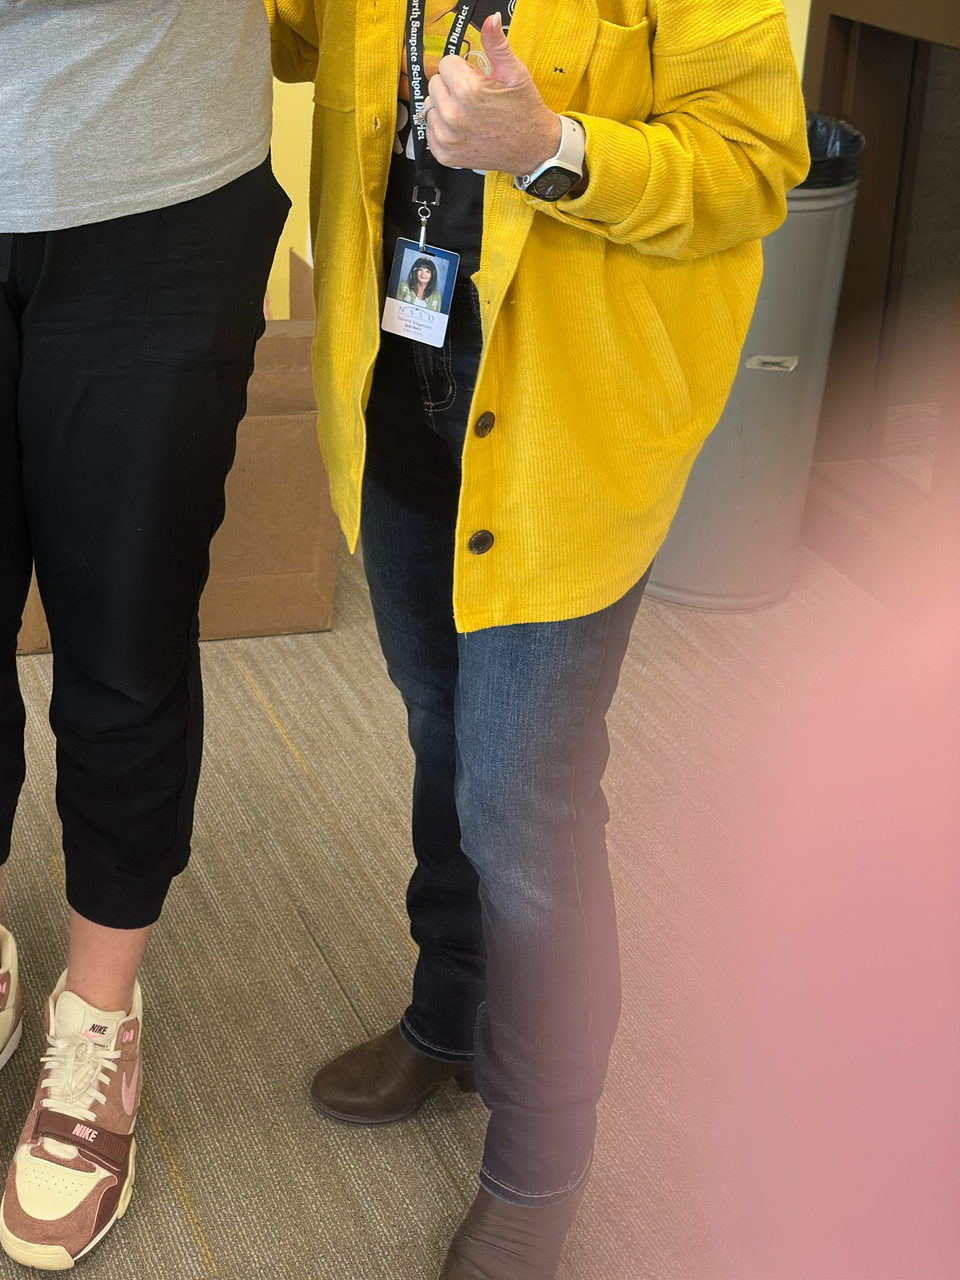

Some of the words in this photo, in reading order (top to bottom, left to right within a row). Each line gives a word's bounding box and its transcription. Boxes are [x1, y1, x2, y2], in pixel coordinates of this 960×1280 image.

[409, 21, 421, 62] Sanpete
[449, 5, 469, 45] District
[411, 64, 424, 100] School
[89, 1023, 108, 1035] NIKE
[72, 1123, 98, 1142] NIKE
